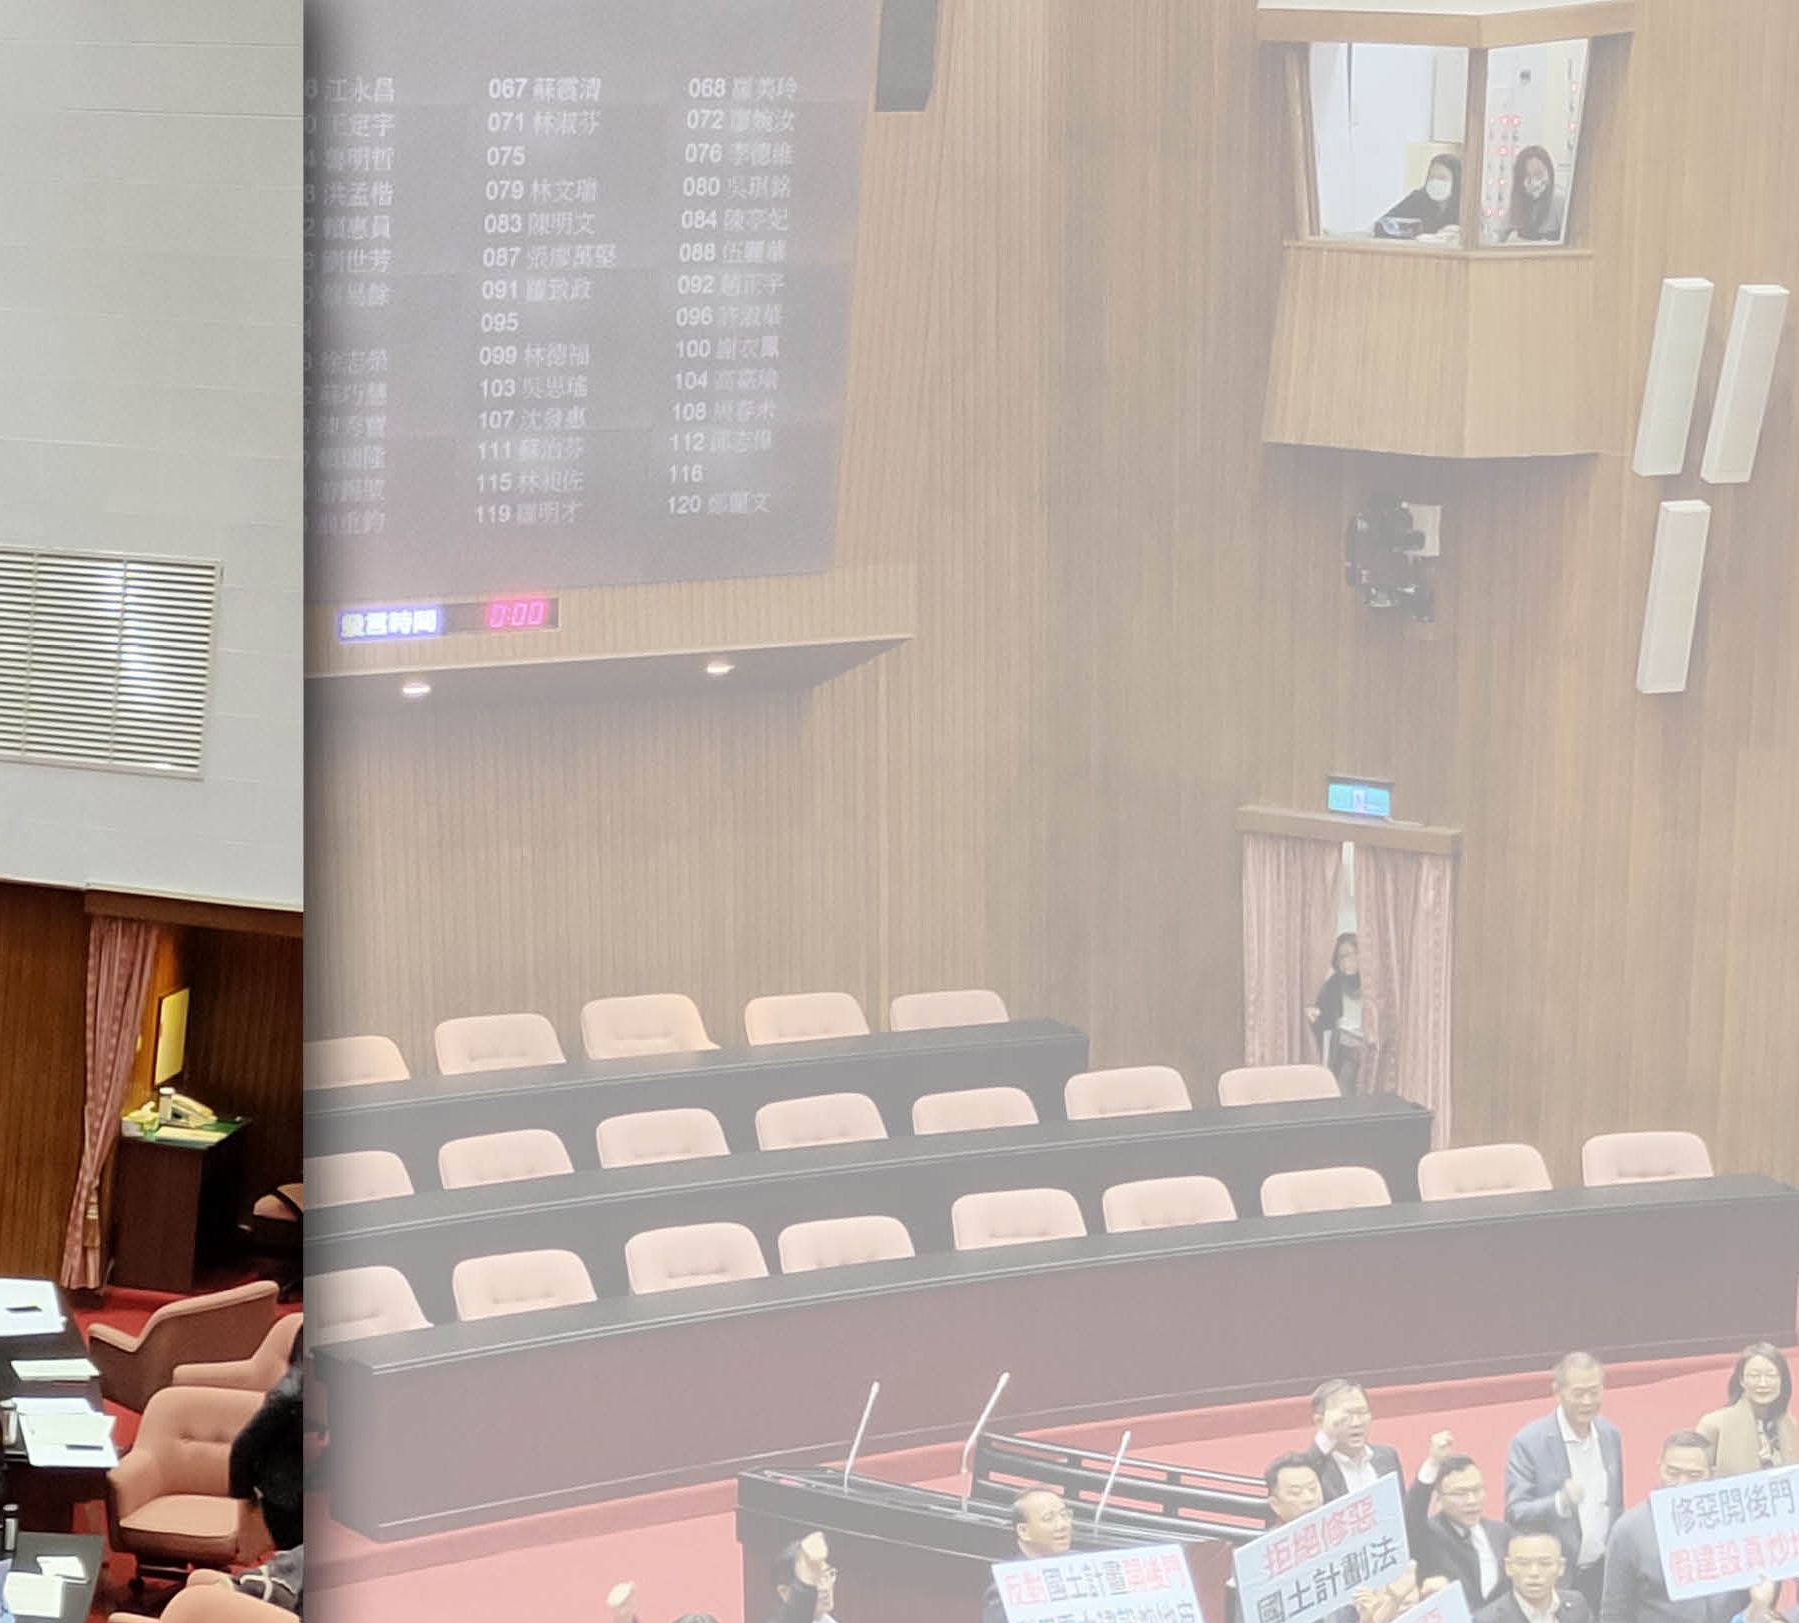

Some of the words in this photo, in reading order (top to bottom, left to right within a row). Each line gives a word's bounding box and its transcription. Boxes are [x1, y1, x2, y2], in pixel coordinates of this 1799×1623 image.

[1264, 1496, 1375, 1581] 拒絕修惡
[1670, 1478, 1795, 1537] 修惡開後門
